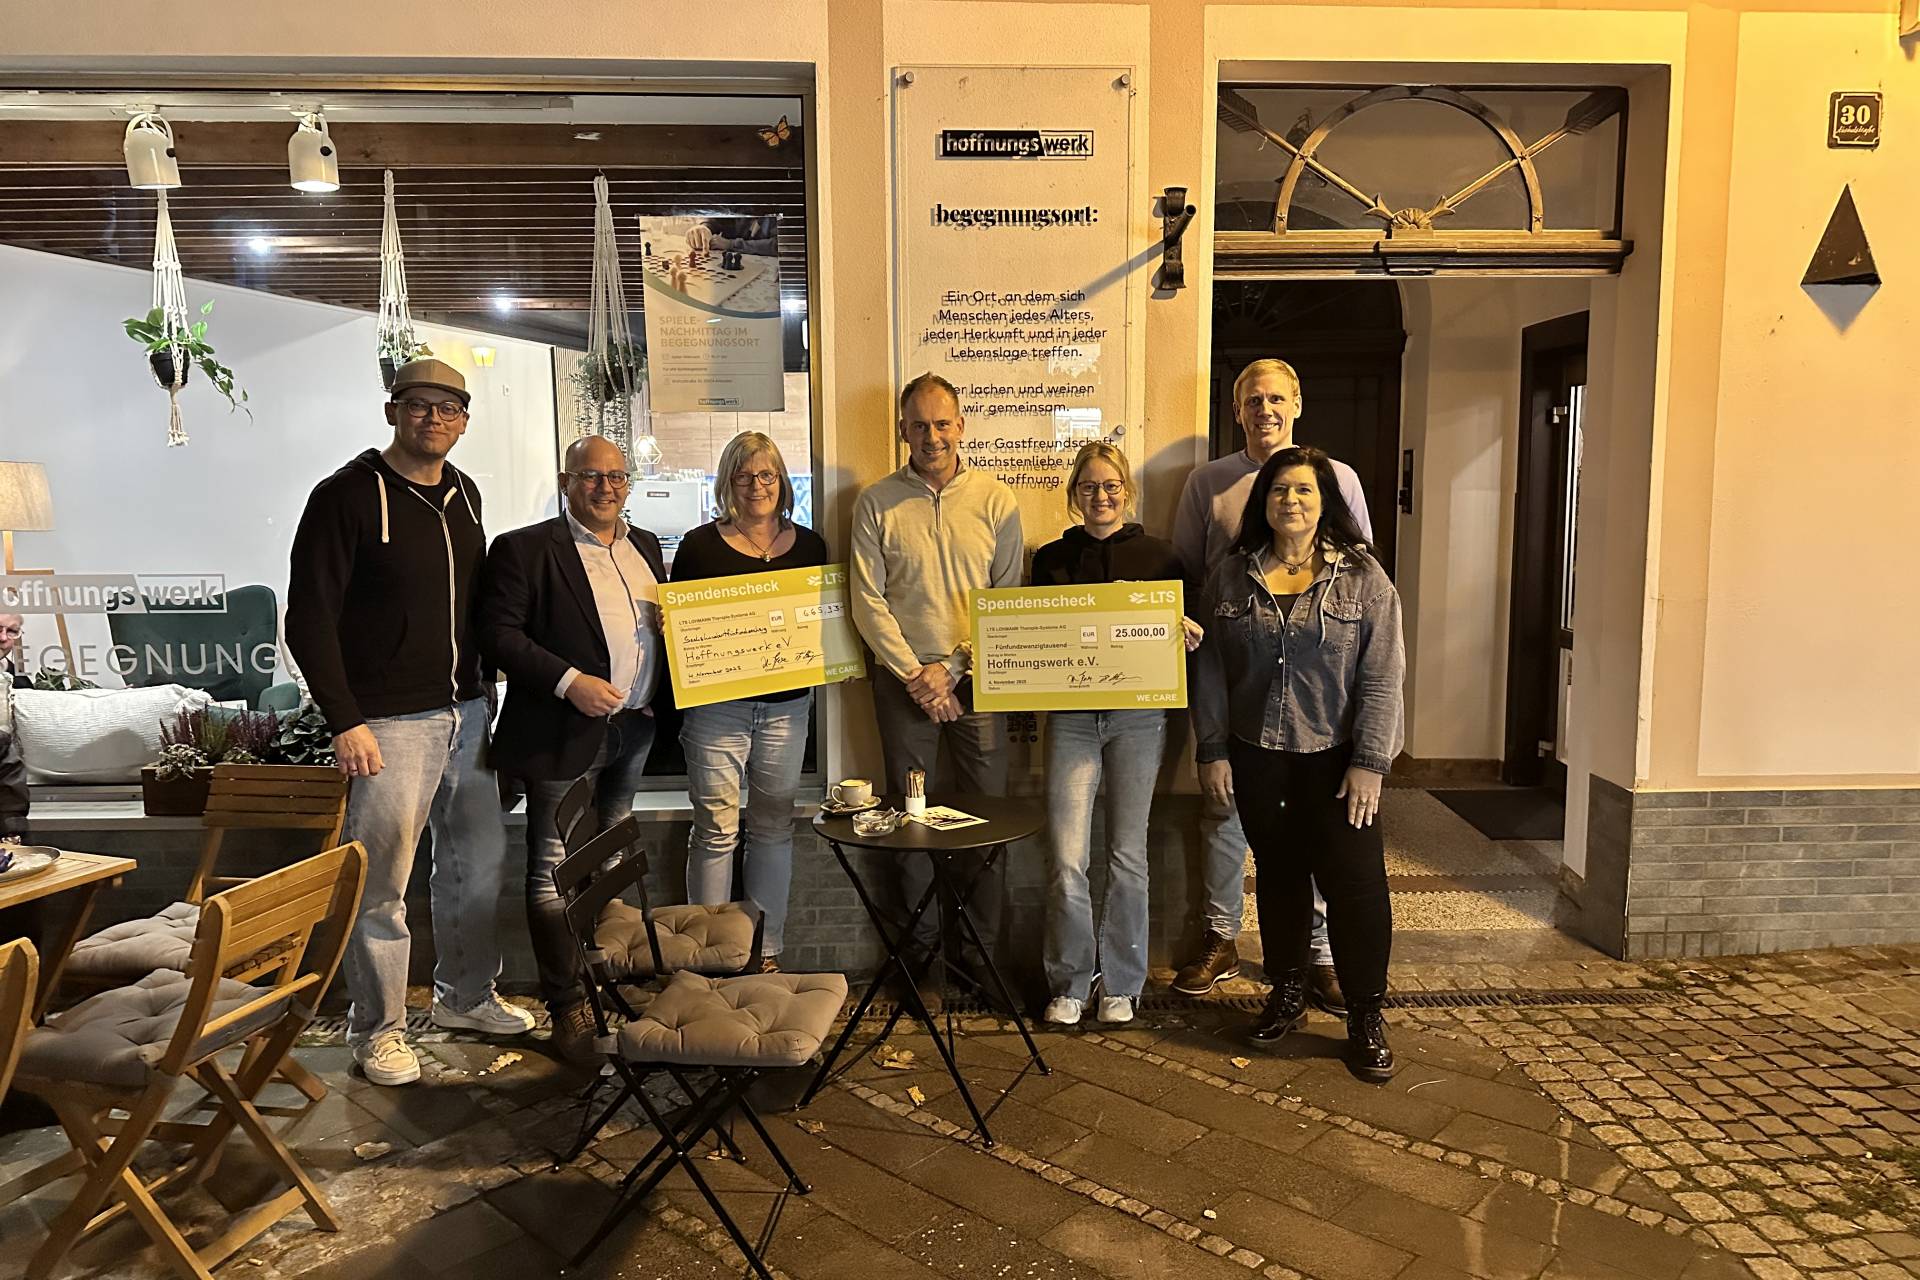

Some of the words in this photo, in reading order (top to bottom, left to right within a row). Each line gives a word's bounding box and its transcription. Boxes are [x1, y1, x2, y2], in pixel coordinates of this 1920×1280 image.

[1841, 105, 1871, 125] 30
[937, 203, 1099, 228] begegnungsort:
[947, 291, 968, 302] Ein
[972, 291, 1001, 304] Ort,
[1005, 293, 1023, 302] an
[1026, 290, 1055, 302] dem
[1059, 290, 1086, 302] sich
[659, 316, 701, 325] SPIELE-
[939, 309, 1007, 321] Menschen
[1010, 309, 1046, 323] jedes
[1050, 309, 1094, 322] Alters,
[660, 327, 731, 336] NACHMITTAG
[734, 327, 748, 335] IM
[923, 329, 959, 342] jeder
[964, 328, 1024, 339] Herkunft
[1029, 328, 1053, 339] und
[1057, 328, 1069, 339] in
[1072, 328, 1107, 341] jeder
[661, 338, 760, 348] BEGEGNUNGSORT
[951, 347, 1028, 361] Lebenslage
[1032, 347, 1083, 358] treffen.
[954, 386, 967, 395] er
[970, 384, 1014, 395] lachen
[1019, 384, 1043, 395] und
[1049, 385, 1094, 395] weinen
[964, 403, 984, 413] wir
[989, 404, 1070, 416] gemeinsam.
[968, 438, 990, 449] der
[968, 454, 1063, 467] Nächstenliebe
[997, 473, 1064, 488] Hoffnung.
[824, 572, 846, 585] LTS
[2, 580, 135, 611] offnungs
[144, 580, 220, 606] werk
[666, 580, 779, 606] Spendenscheck
[1150, 591, 1175, 604] LTS
[977, 593, 1096, 612] Spendenscheck
[1115, 627, 1165, 638] 25.000,00
[685, 640, 773, 662] Hoffnungswerk
[14, 643, 281, 676] EGEGNUNG
[987, 657, 1074, 669] Hoffnungswerk
[1077, 656, 1099, 667] e.V.
[825, 667, 838, 677] WE
[840, 665, 859, 675] CARE
[1136, 694, 1151, 702] WE
[1153, 693, 1177, 701] CARE
